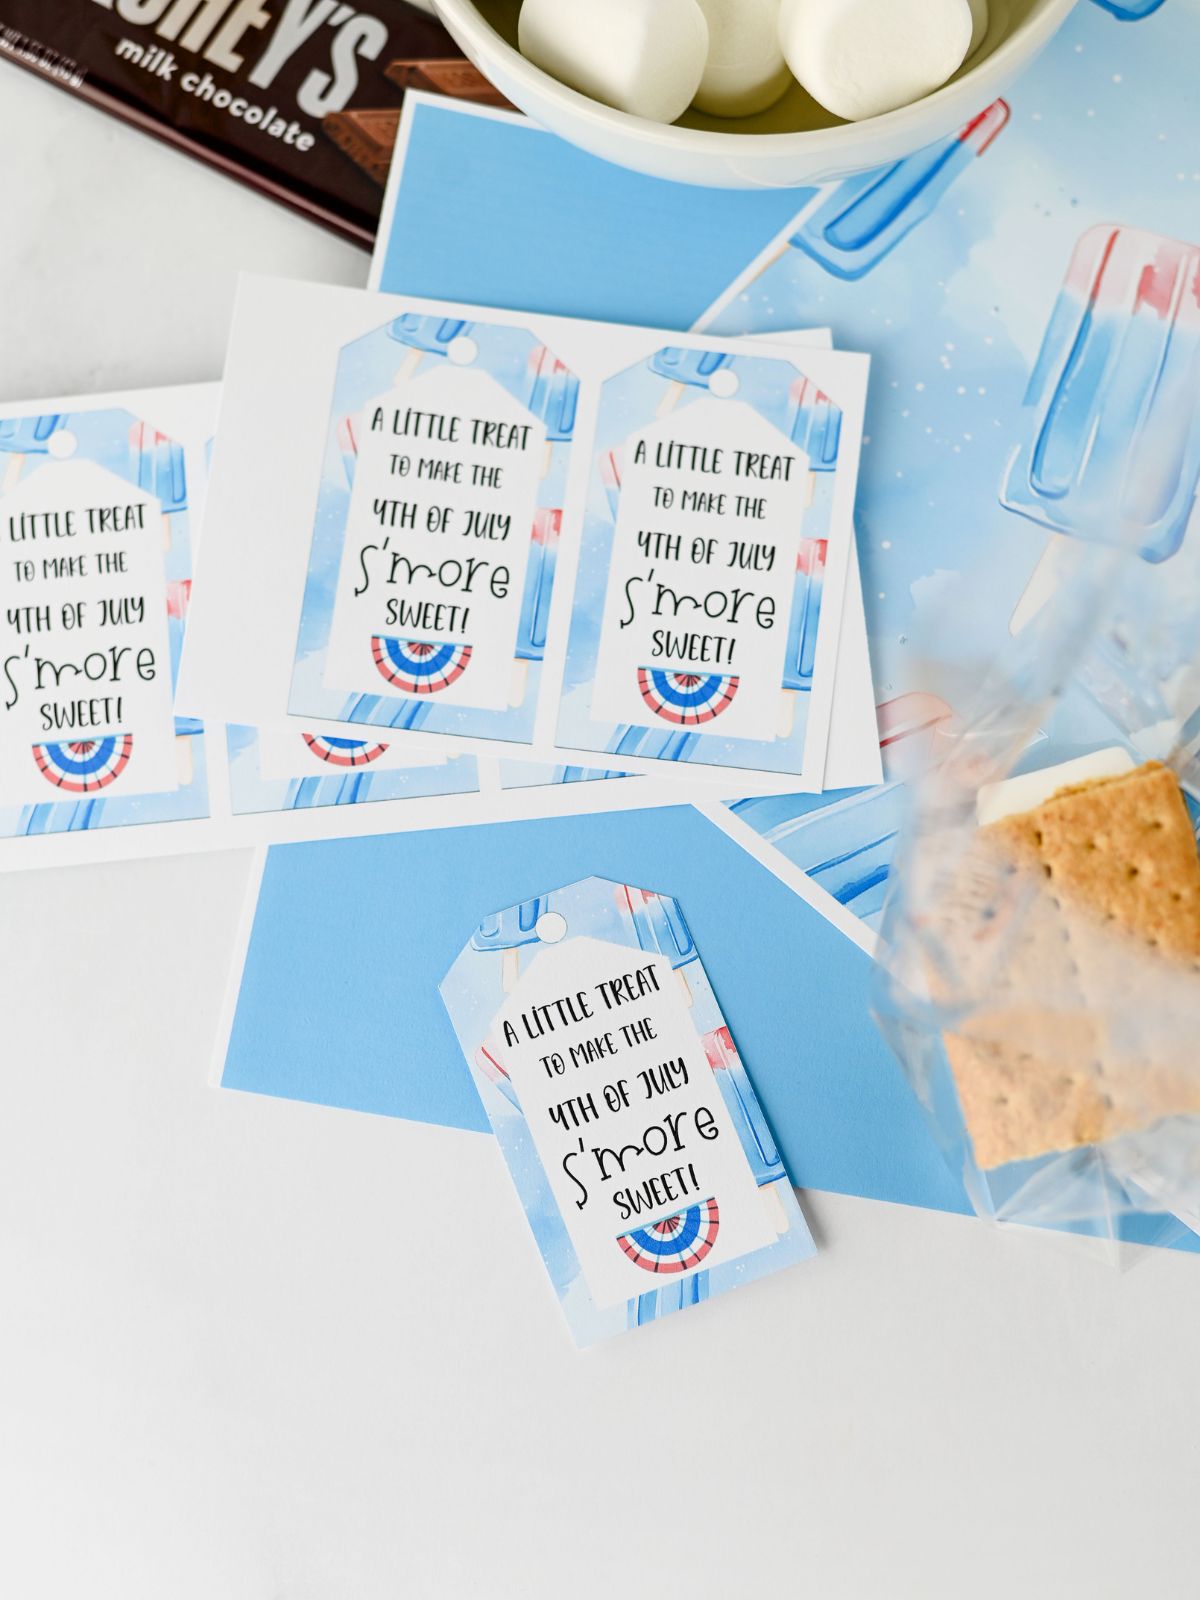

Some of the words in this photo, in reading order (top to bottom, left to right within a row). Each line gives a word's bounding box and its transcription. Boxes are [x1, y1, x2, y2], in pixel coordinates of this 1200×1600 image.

[115, 38, 178, 82] milk
[180, 71, 316, 152] chocolate
[371, 406, 384, 432] A
[470, 418, 533, 451] TREAT
[390, 453, 411, 477] TO
[417, 457, 463, 484] MAKE
[471, 463, 504, 489] THE
[634, 439, 647, 464] A
[733, 449, 796, 482] TREAT
[85, 503, 147, 534] TREAT
[373, 498, 418, 530] 4TH
[426, 505, 455, 534] OF
[462, 510, 512, 541] JULY
[653, 486, 675, 509] TO
[681, 489, 727, 516] MAKE
[735, 495, 768, 520] THE
[13, 559, 36, 582] TO
[43, 554, 88, 579] MAKE
[95, 551, 128, 575] THE
[637, 530, 682, 561] 4TH
[690, 537, 719, 565] OF
[727, 541, 777, 572] JULY
[7, 605, 52, 634] 4TH
[61, 601, 87, 630] OF
[98, 596, 145, 627] JULY
[385, 598, 471, 634] SWEET!
[651, 629, 737, 665] SWEET!
[39, 696, 123, 731] SWEET!
[502, 1019, 520, 1048] A
[594, 964, 661, 1010] TREAT
[538, 1052, 566, 1079] TO
[568, 1032, 619, 1069] MAKE
[618, 1017, 658, 1048] THE
[548, 1092, 600, 1131] 4TH
[602, 1079, 630, 1113] OF
[636, 1056, 690, 1100] JULY
[612, 1163, 701, 1220] SWEET!
